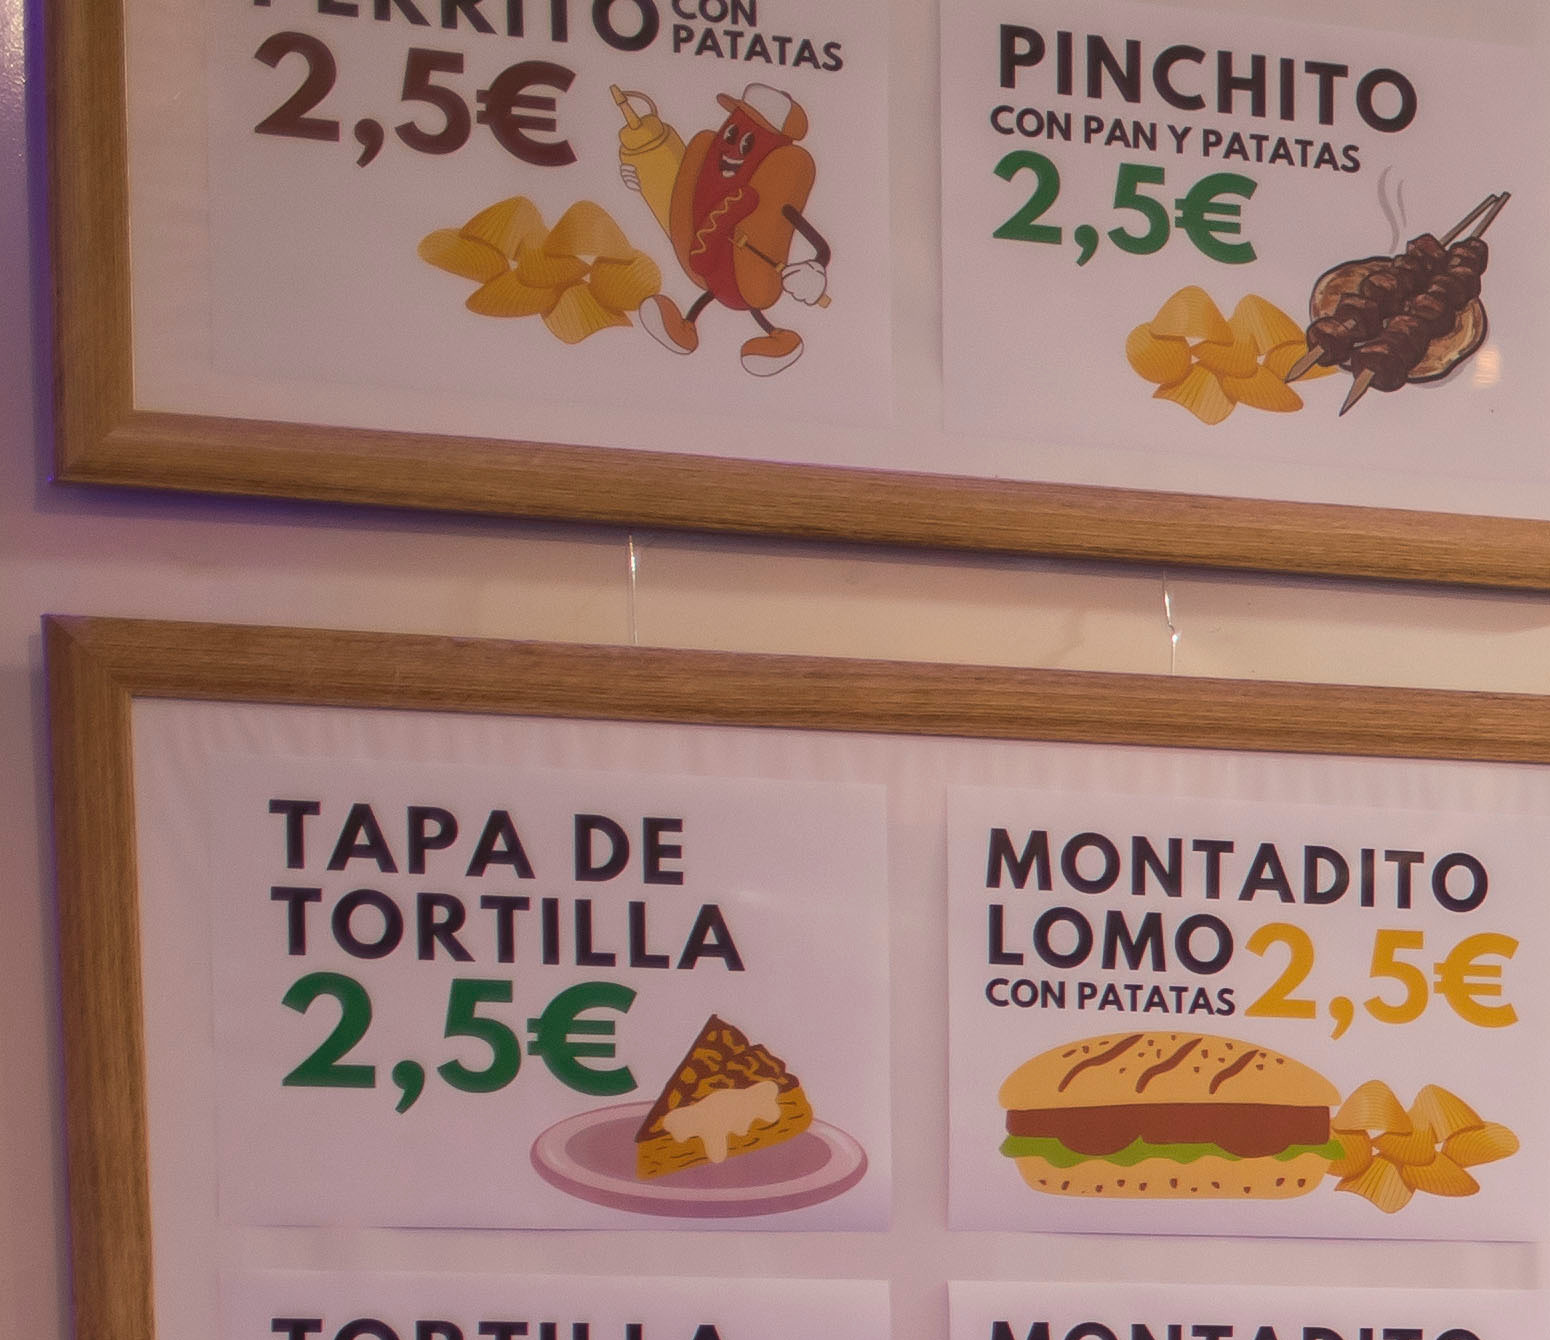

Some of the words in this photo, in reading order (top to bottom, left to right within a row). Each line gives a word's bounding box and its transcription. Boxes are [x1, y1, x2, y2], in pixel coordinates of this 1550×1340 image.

[672, 0, 757, 27] CON
[673, 27, 843, 71] PATATAS
[254, 31, 577, 168] 2,5€
[997, 24, 1418, 134] PINCHITO
[991, 105, 1071, 141] CON
[1083, 114, 1157, 152] PAN
[1167, 125, 1192, 155] Y
[1203, 130, 1361, 174] PATATAS
[992, 150, 1258, 266] 2,5€
[269, 799, 535, 879] TAPA
[575, 814, 683, 885] DE
[986, 828, 1488, 912] MONTADITO
[271, 887, 745, 972] TORTILLA
[988, 904, 1233, 975] LOMO
[1244, 923, 1519, 1040] 2,5€
[985, 978, 1065, 1009] CON
[1077, 981, 1235, 1016] PATATAS
[282, 972, 638, 1114] 2,5€
